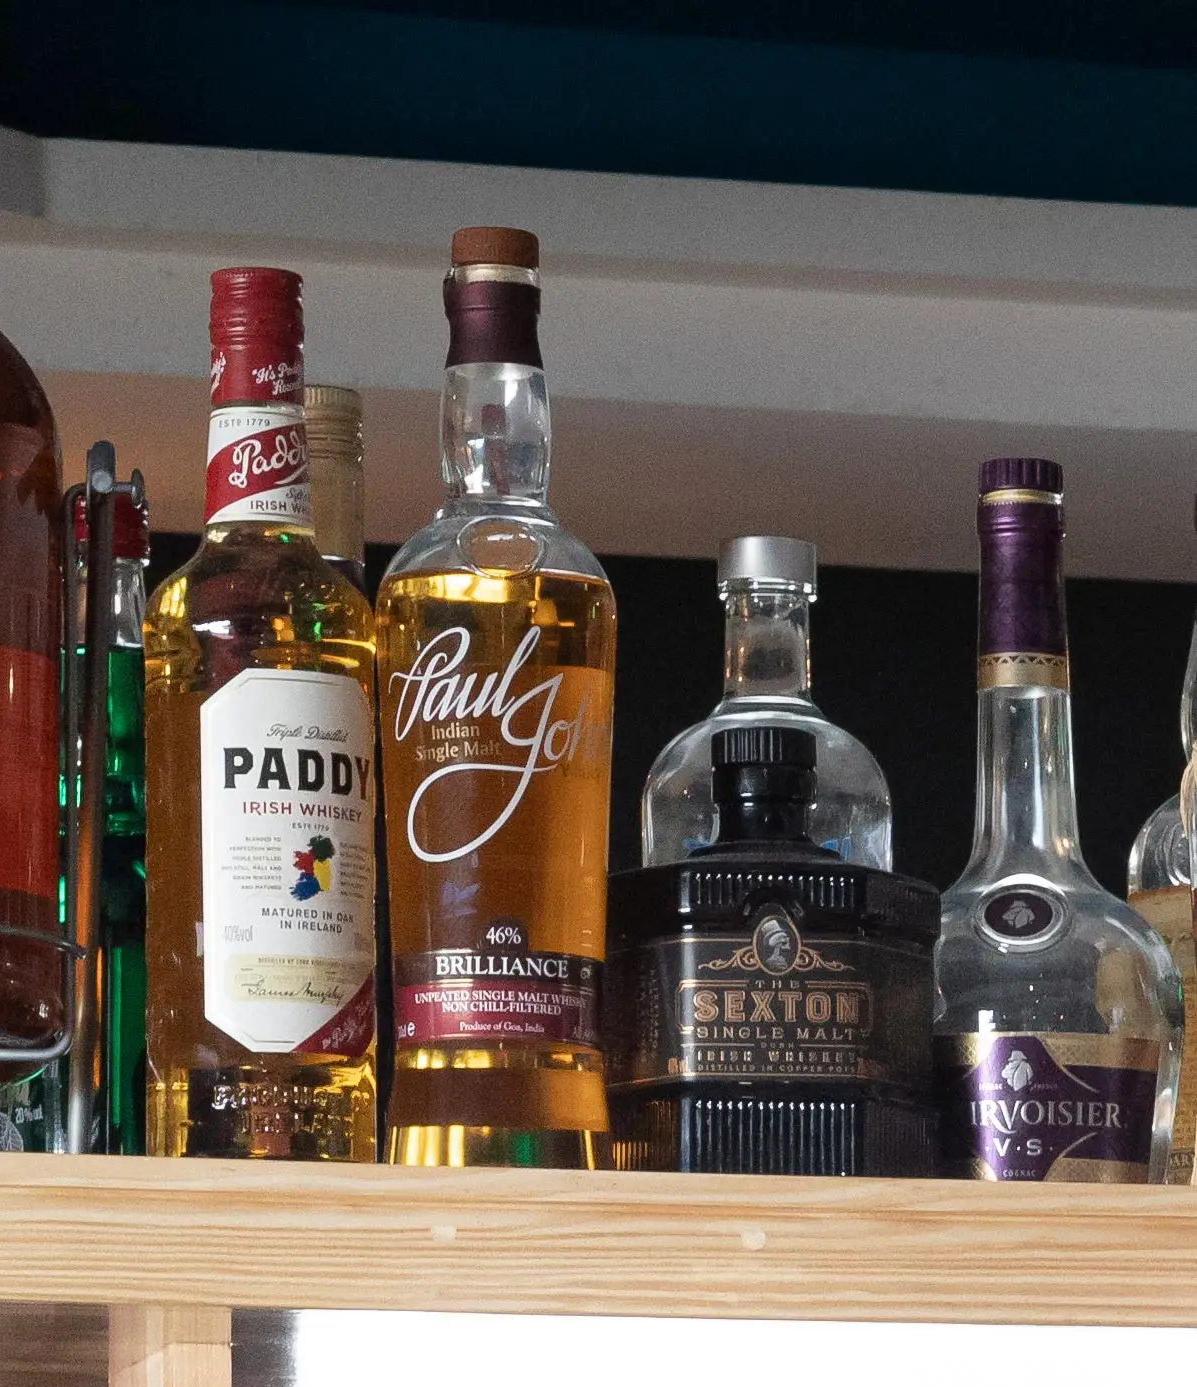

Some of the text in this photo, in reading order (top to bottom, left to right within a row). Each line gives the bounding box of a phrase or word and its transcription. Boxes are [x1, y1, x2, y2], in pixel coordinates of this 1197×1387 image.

[246, 418, 271, 427] 1779
[228, 429, 306, 488] Padd
[250, 500, 287, 512] IRISH
[388, 625, 541, 741] Paul
[266, 723, 349, 743] Triple Distilled
[431, 721, 480, 741] Indian
[415, 741, 502, 763] Single Malt
[223, 747, 370, 800] PADDY
[243, 801, 362, 823] IRISH WHISKEY
[261, 907, 354, 923] MATURED IN OAK
[280, 921, 343, 934] IN IRELAND
[486, 926, 522, 945] 46%
[435, 955, 569, 979] BRILLIANCE
[755, 979, 800, 989] THE
[415, 990, 469, 1005] UNPEATED
[471, 990, 515, 1002] SINGLE
[518, 991, 551, 1004] MALT
[442, 1001, 562, 1016] NON CHILL-FILTERED
[693, 989, 860, 1024] SEXTON
[459, 1021, 491, 1032] Produce
[493, 1021, 502, 1031] of
[525, 1023, 545, 1034] India
[696, 1026, 855, 1041] SINGLE MALT
[697, 1050, 856, 1063] IRISH WHISKEY
[697, 1064, 755, 1073] DISTILLED
[762, 1064, 773, 1073] IN
[778, 1064, 823, 1073] COPPER
[970, 1100, 1122, 1135] RVOISIER
[1002, 1169, 1037, 1178] COGNAC
